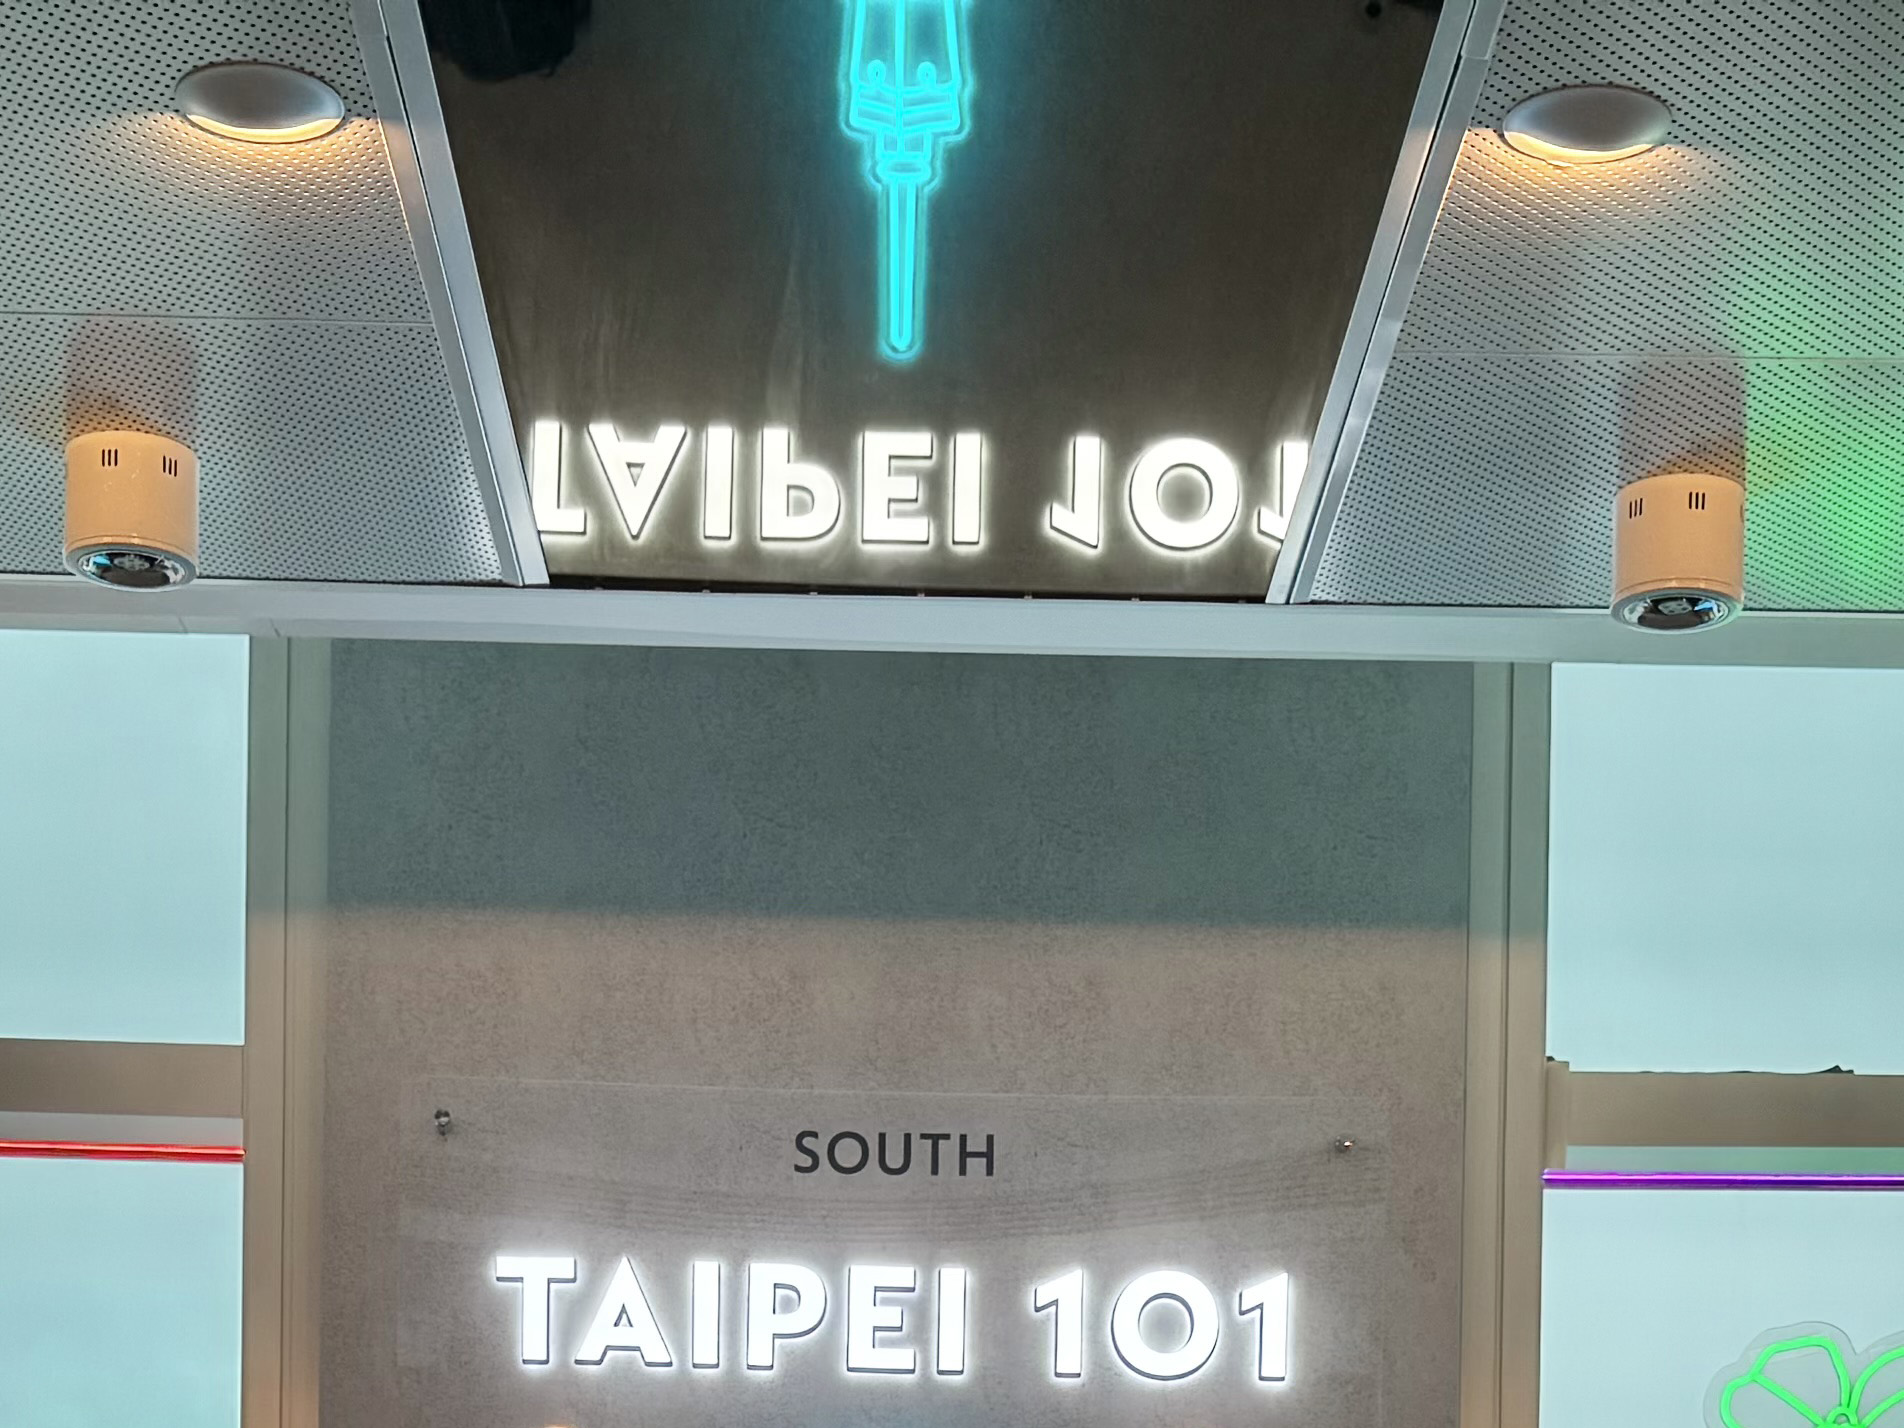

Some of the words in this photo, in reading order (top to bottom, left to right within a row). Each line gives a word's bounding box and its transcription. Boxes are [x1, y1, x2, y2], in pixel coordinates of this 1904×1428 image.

[793, 1129, 996, 1178] SOUTH
[494, 1254, 968, 1377] TAIPEI
[1032, 1266, 1290, 1384] 101
